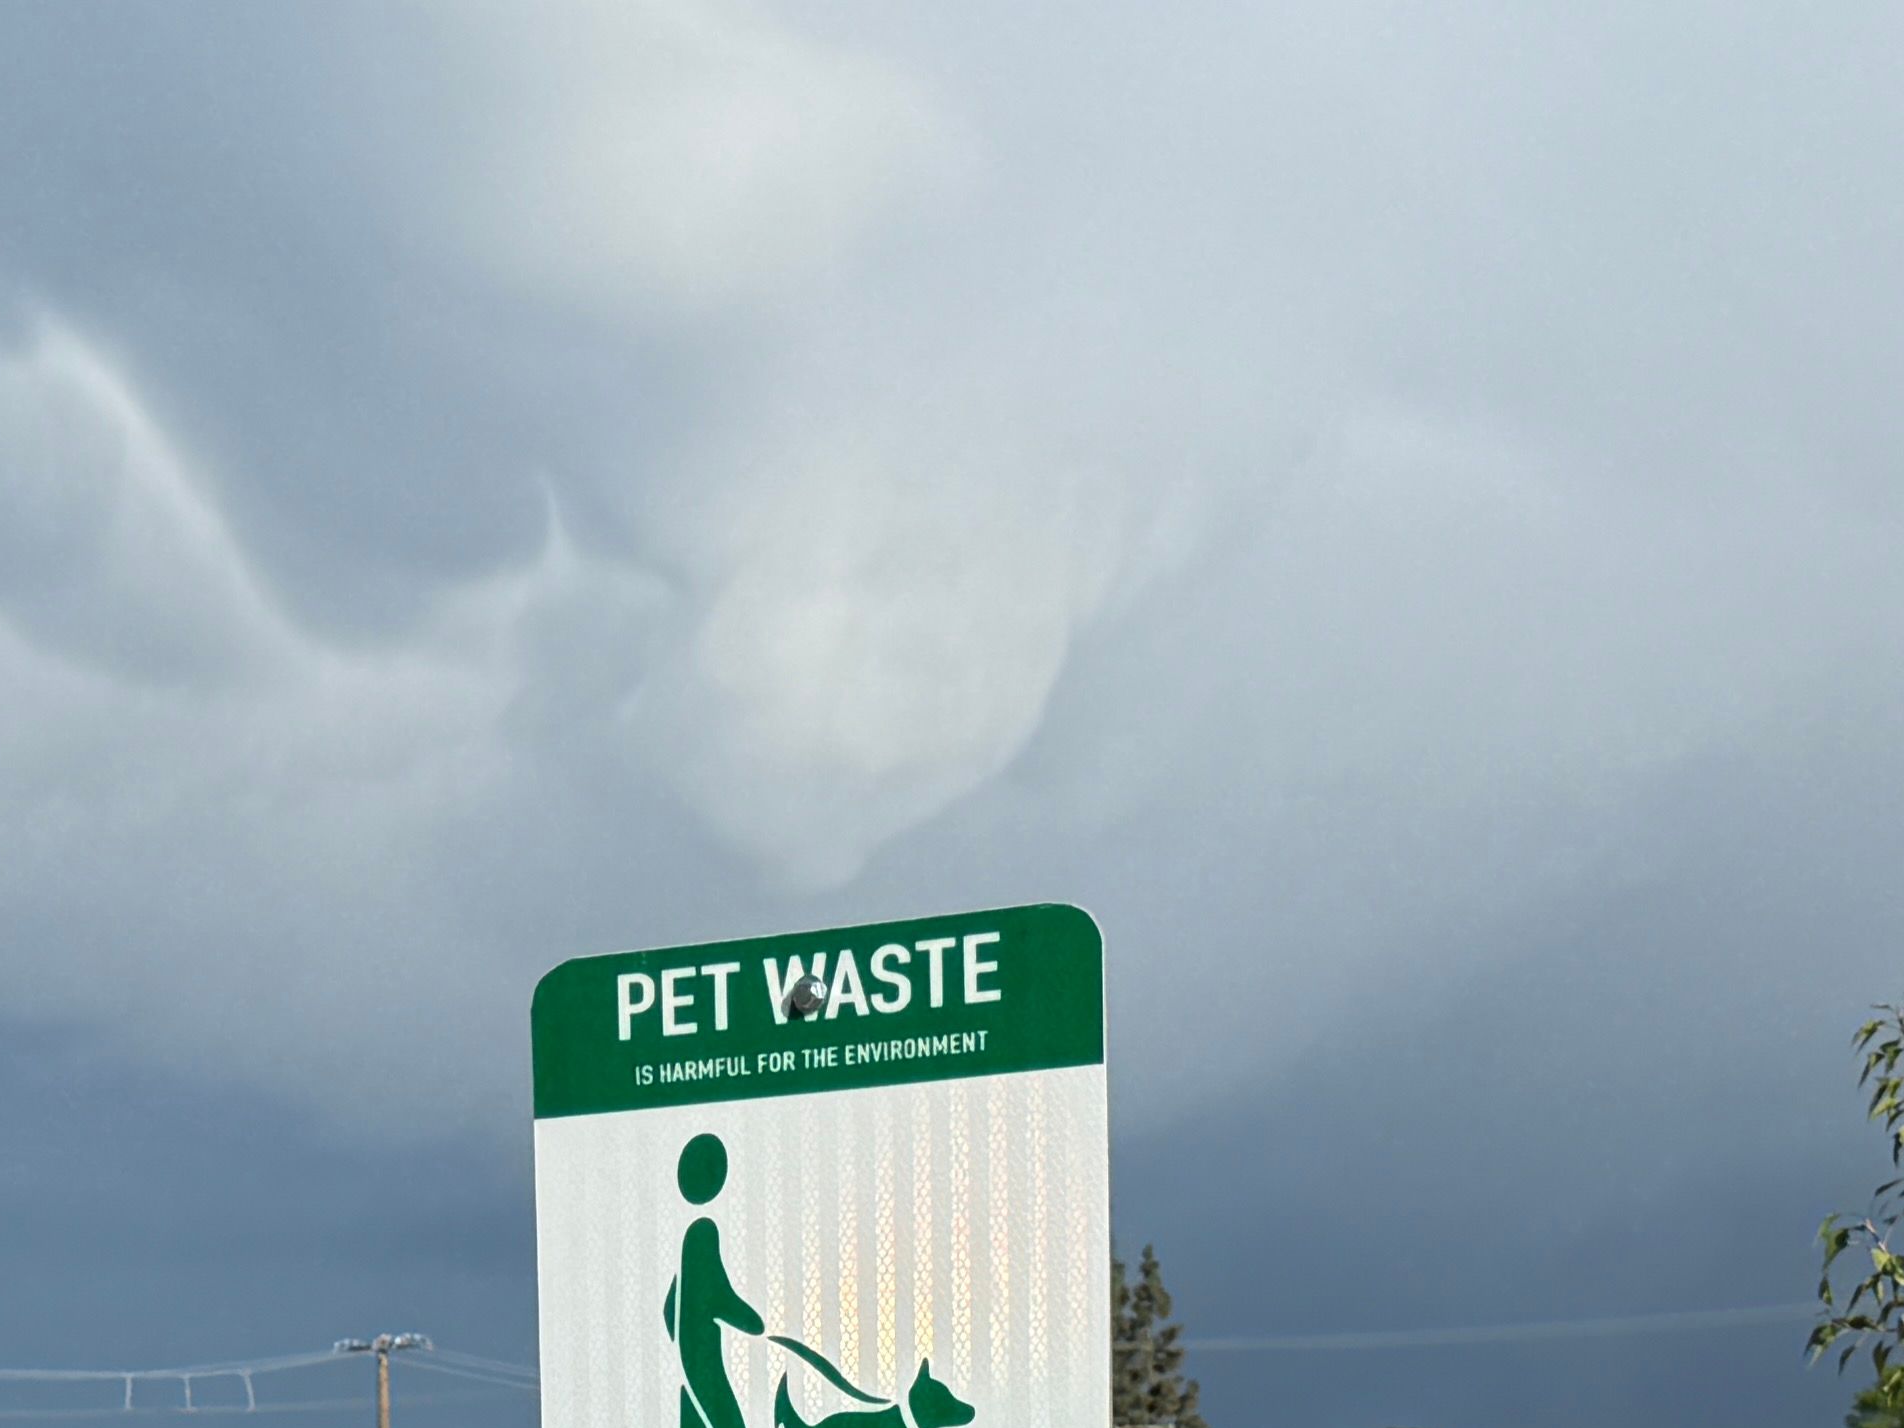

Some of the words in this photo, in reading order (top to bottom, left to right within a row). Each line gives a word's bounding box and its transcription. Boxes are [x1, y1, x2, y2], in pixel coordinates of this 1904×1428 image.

[617, 961, 741, 1041] PET
[762, 931, 1002, 1025] WASTE
[634, 1064, 654, 1086] IS
[659, 1055, 751, 1084] HARMFUL
[757, 1050, 796, 1075] FOR
[801, 1046, 839, 1070] THE
[844, 1030, 989, 1066] ENVIRONMENT
